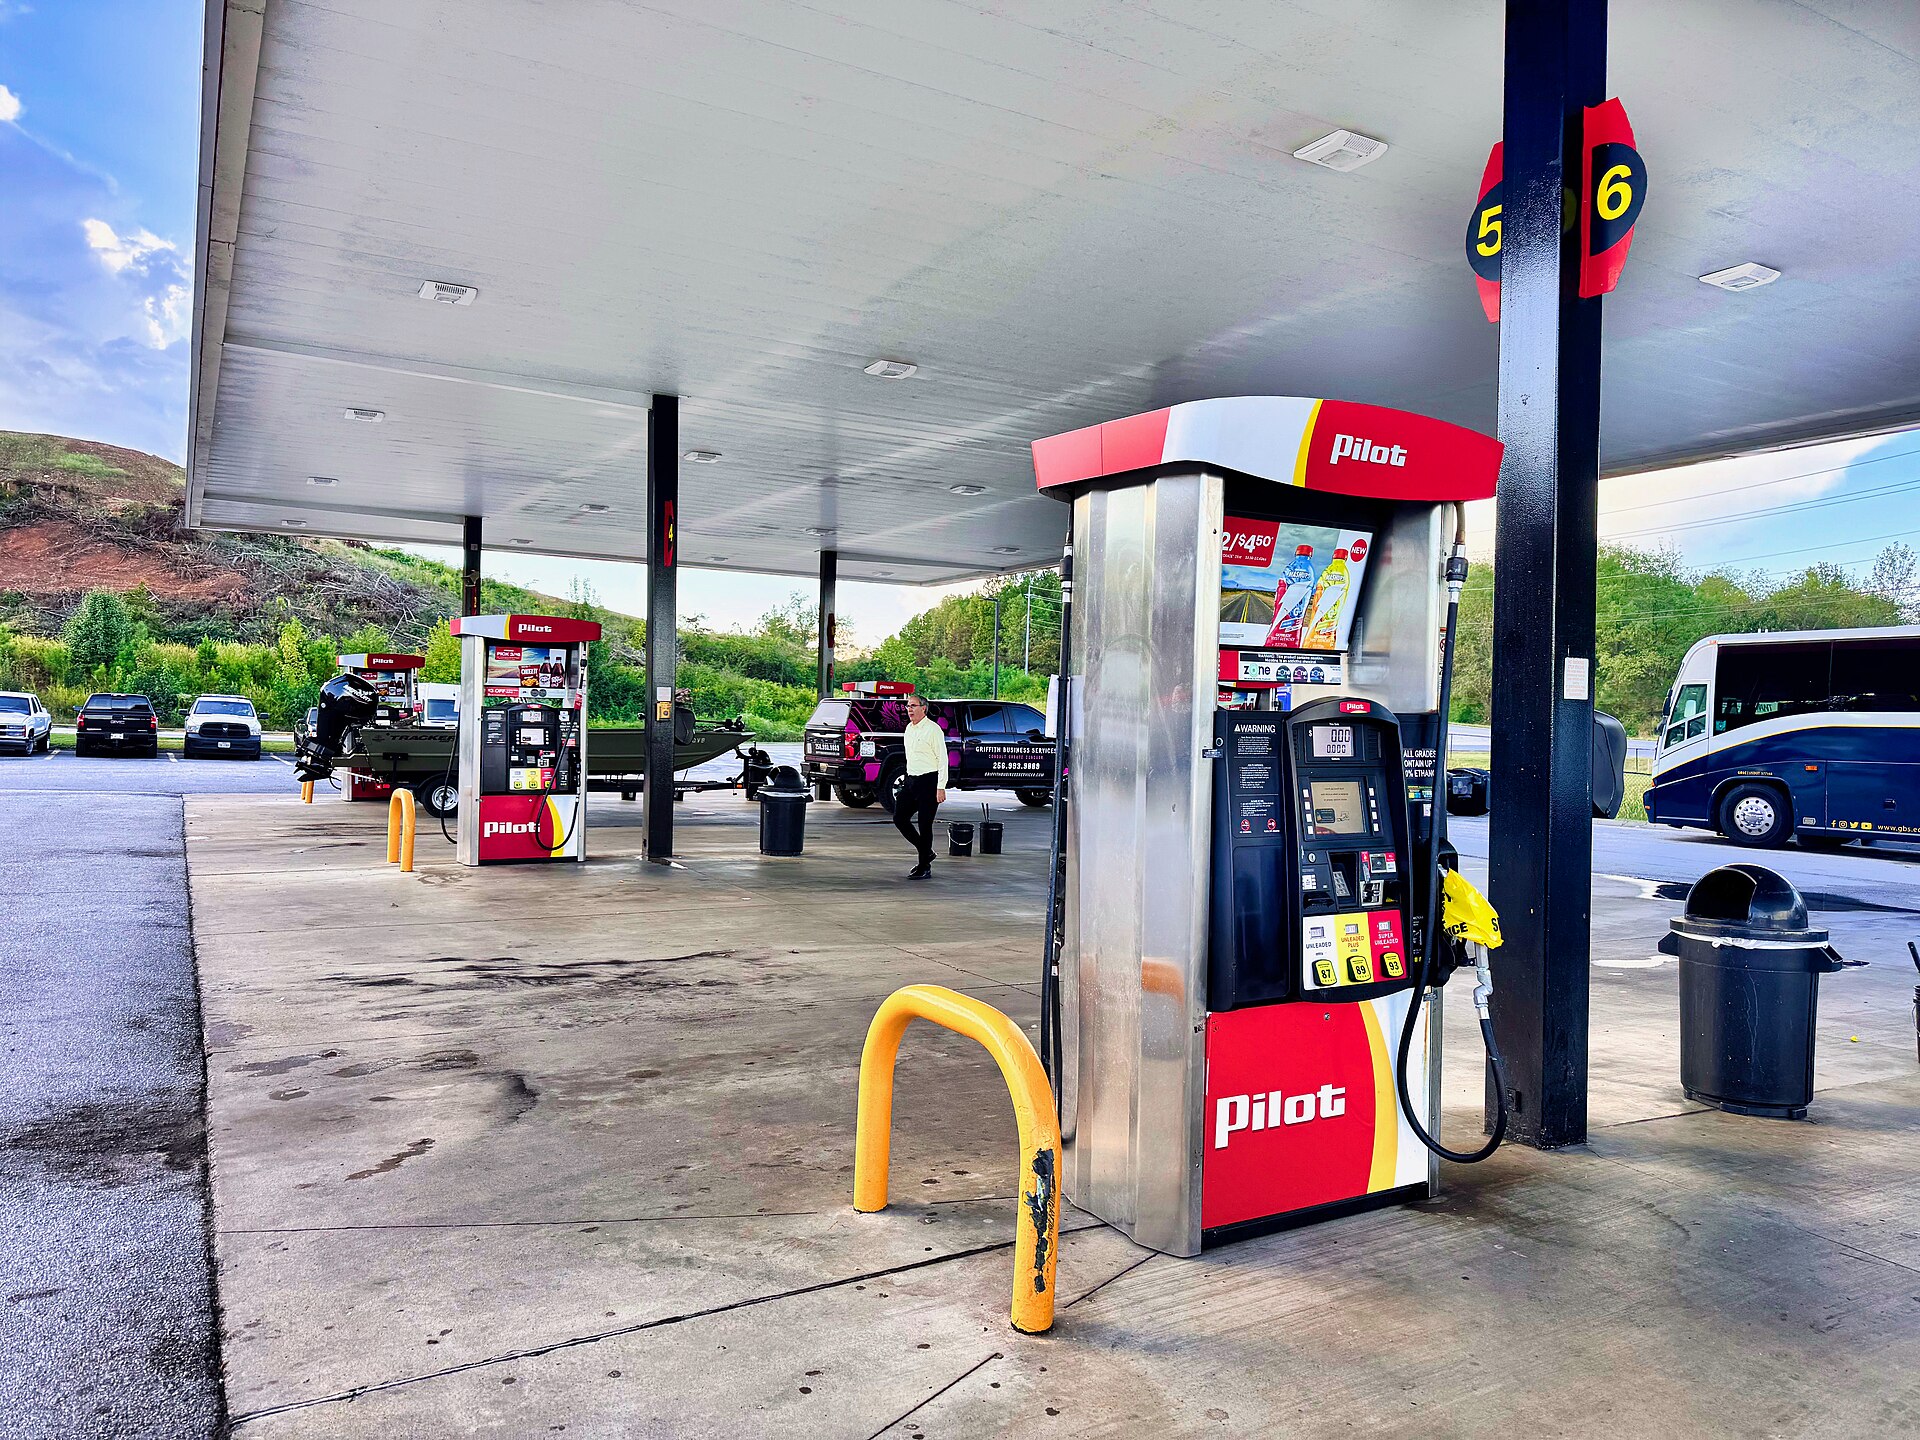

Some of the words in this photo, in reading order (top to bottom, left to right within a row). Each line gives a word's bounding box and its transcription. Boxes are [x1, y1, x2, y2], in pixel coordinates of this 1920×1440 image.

[1597, 164, 1632, 221] 6
[1476, 204, 1502, 257] 5
[1330, 434, 1407, 467] Pilot
[667, 523, 674, 542] 4
[1351, 546, 1367, 555] NEW
[518, 623, 552, 633] Pilot
[1240, 724, 1276, 733] WARNING
[1403, 750, 1414, 758] ALL
[1415, 750, 1436, 758] GRADES
[1404, 760, 1424, 768] ONTAIN
[1425, 760, 1433, 768] UP
[484, 821, 540, 838] Pilot
[1355, 965, 1366, 975] 89
[1388, 961, 1399, 971] 93
[1321, 969, 1331, 979] 87
[1215, 1083, 1346, 1149] Pilot
